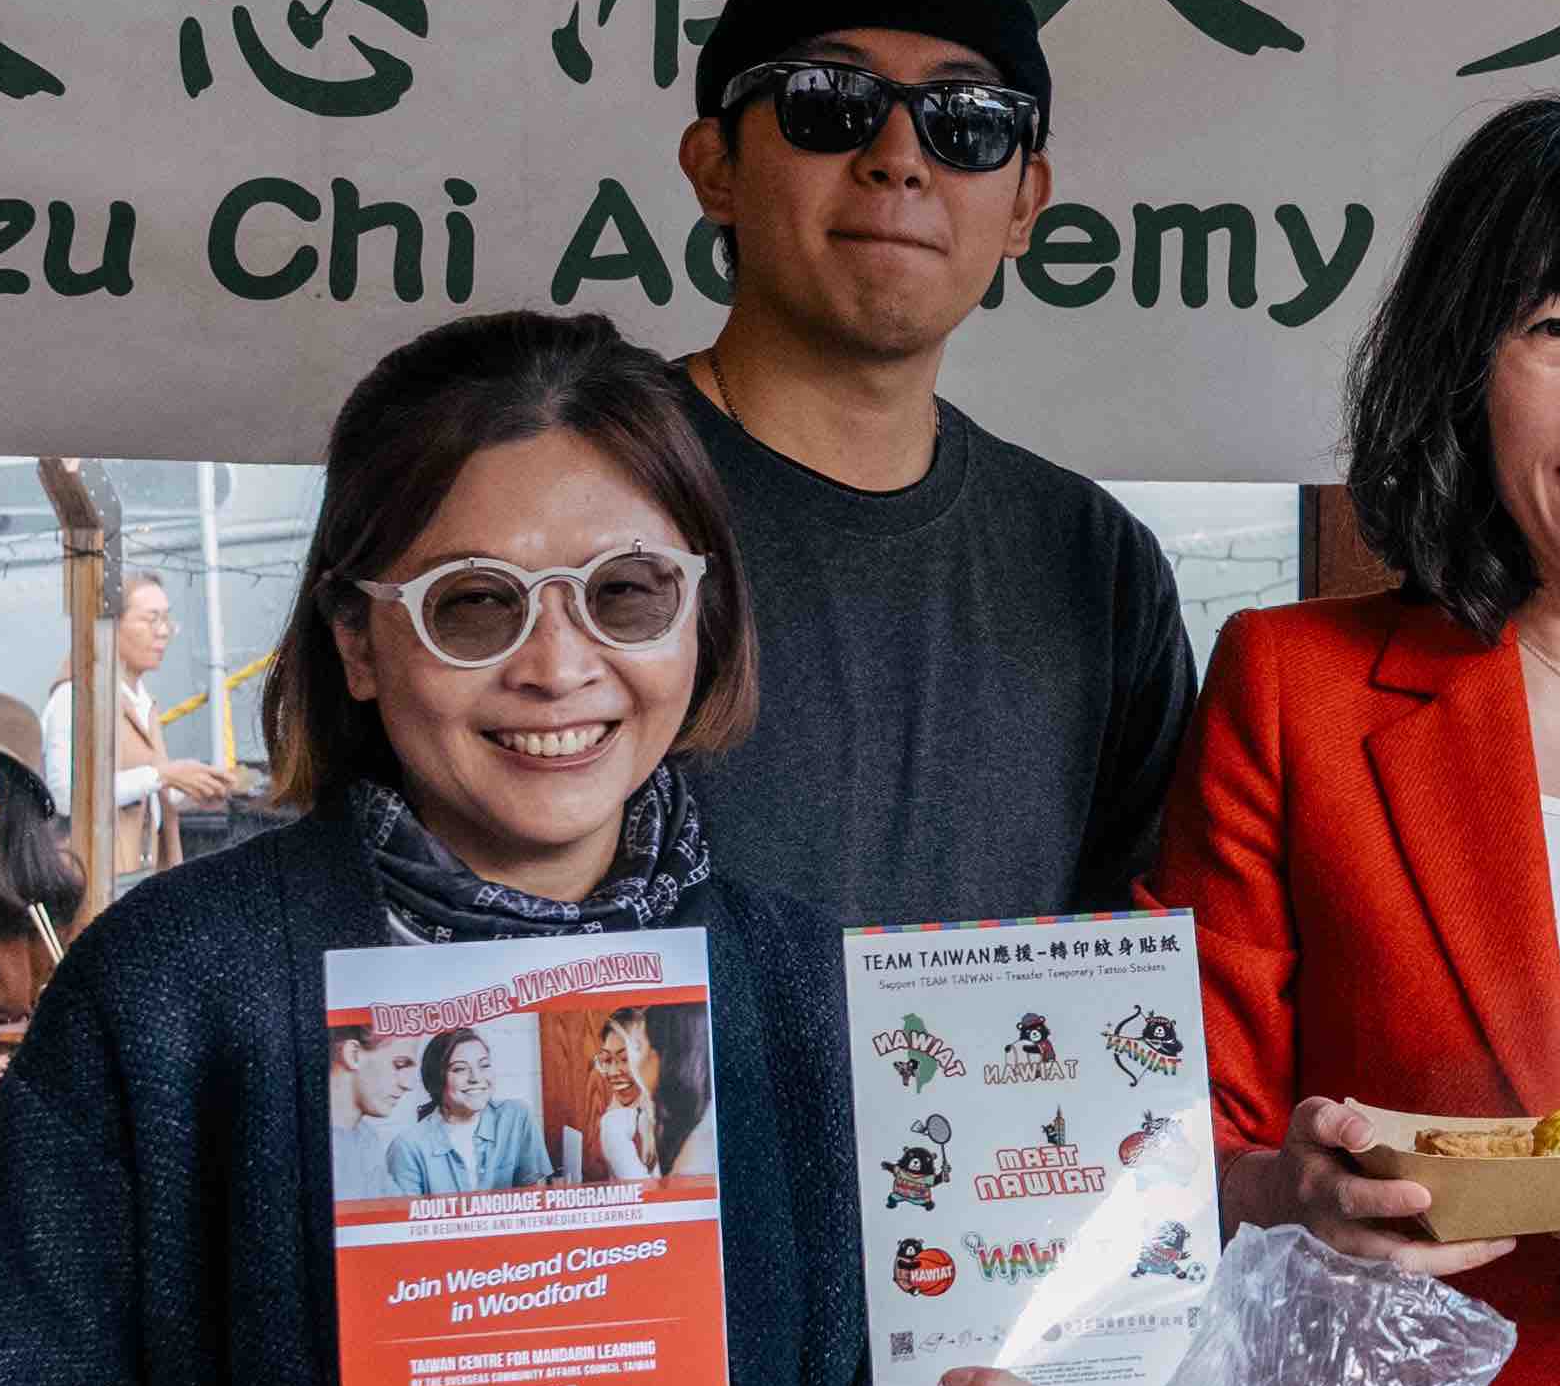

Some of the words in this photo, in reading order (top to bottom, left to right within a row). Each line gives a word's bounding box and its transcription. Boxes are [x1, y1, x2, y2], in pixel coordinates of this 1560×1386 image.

[207, 177, 479, 305] Chi
[862, 951, 913, 972] TEAM
[878, 979, 916, 991] Support
[951, 973, 994, 986] TAIWAN
[1047, 967, 1095, 981] Temporary
[370, 984, 513, 1037] DISCOVER
[512, 951, 664, 1004] MANDARIN
[410, 1196, 458, 1219] ADULT
[462, 1190, 542, 1217] LANGUAGE
[545, 1184, 644, 1210] PROGRAMME
[433, 1219, 489, 1235] BEGINNERS
[515, 1212, 589, 1230] INTERMEDIATE
[387, 1275, 442, 1305] Join
[446, 1252, 562, 1294] Weekend
[566, 1237, 668, 1272] Classes
[451, 1301, 474, 1323] in
[478, 1273, 609, 1318] Woodford!
[458, 1353, 505, 1372] CENTRE
[506, 1350, 530, 1367] FOR
